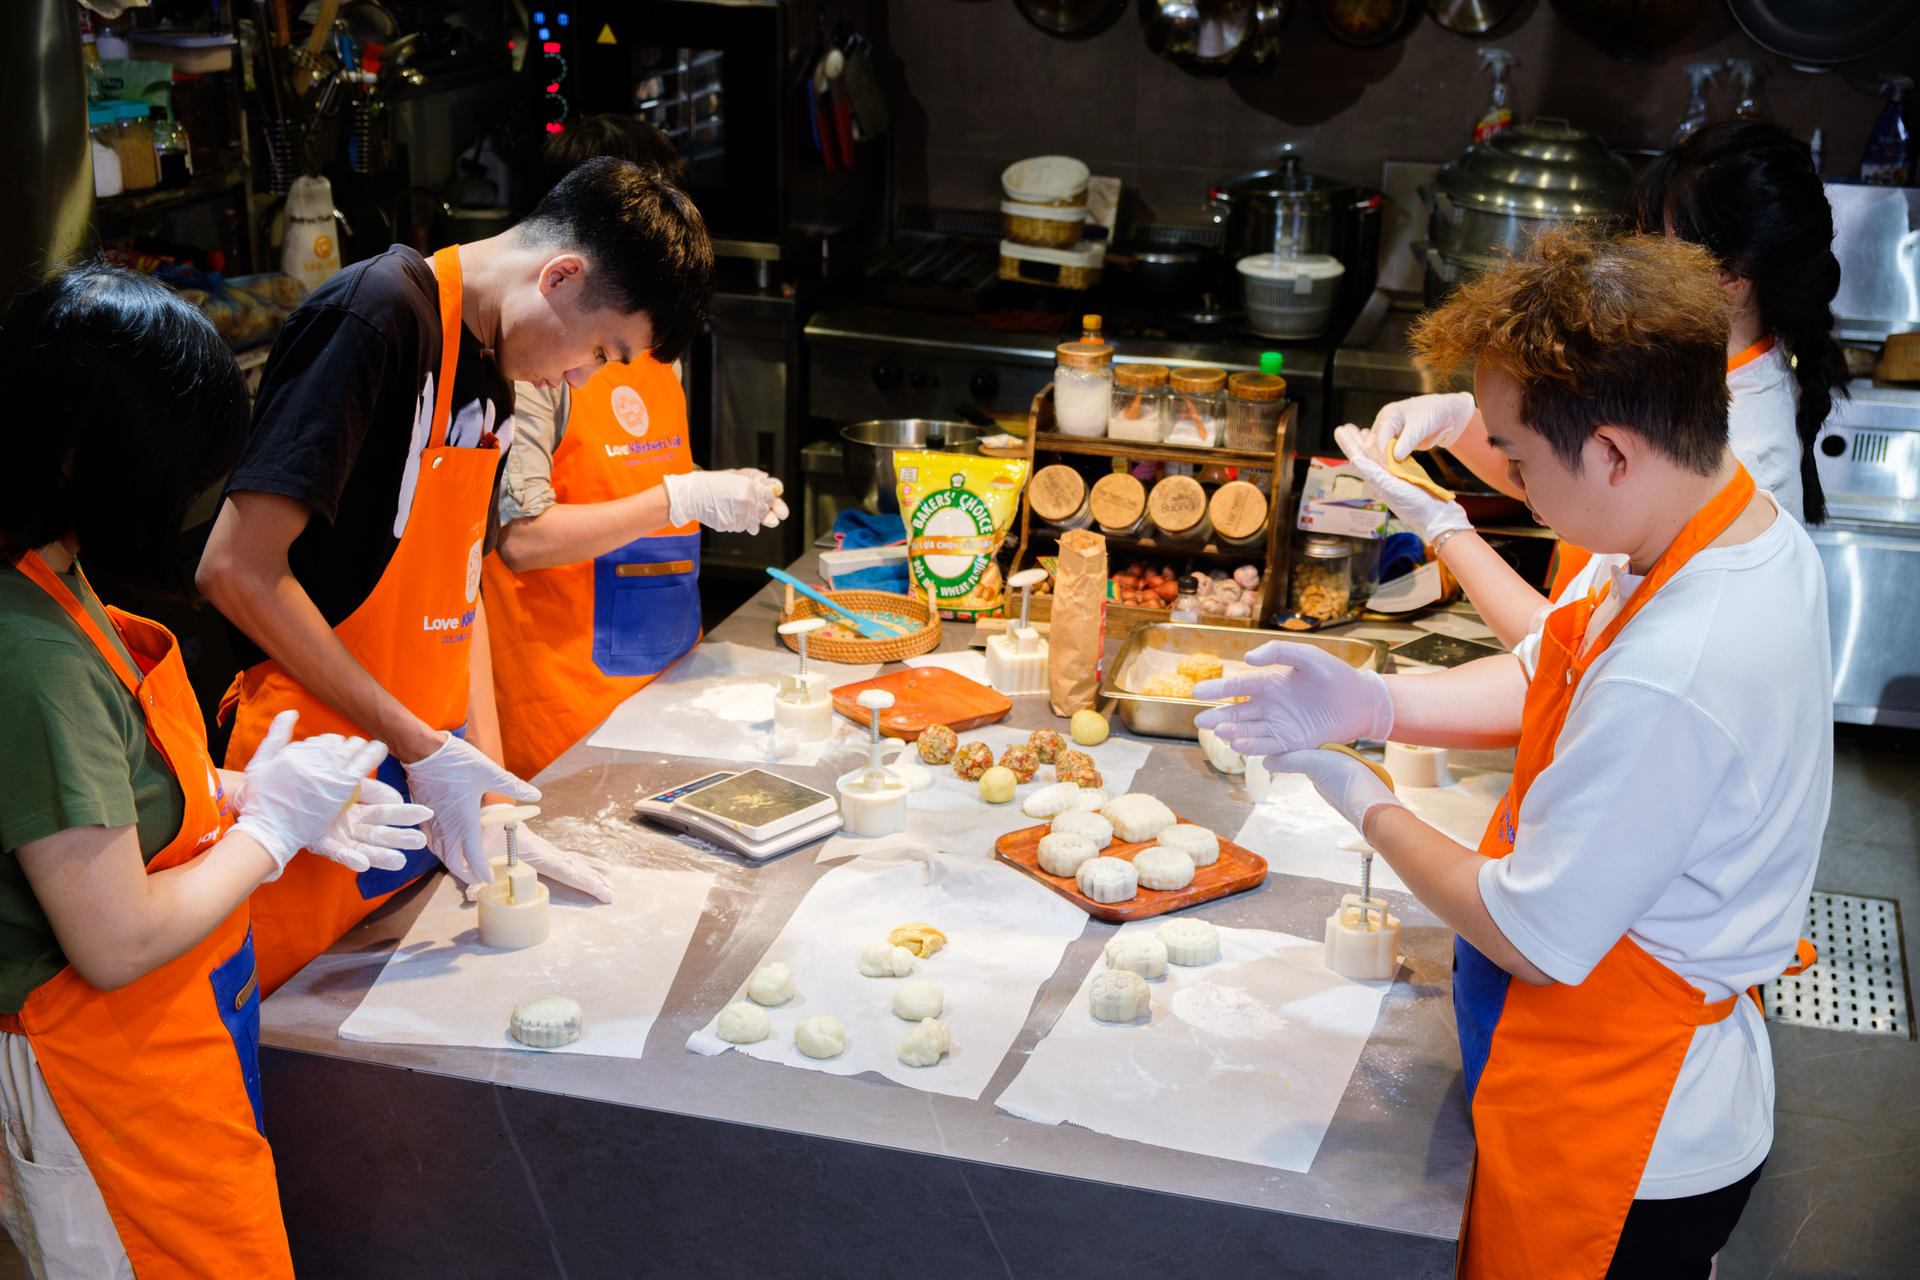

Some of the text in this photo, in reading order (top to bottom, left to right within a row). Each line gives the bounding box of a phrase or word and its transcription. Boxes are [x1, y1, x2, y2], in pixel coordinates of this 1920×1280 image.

[912, 491, 993, 534] BAKERS' CHOICE
[940, 581, 971, 597] WHEAT
[967, 557, 989, 585] FLOUR
[423, 615, 460, 631] Love
